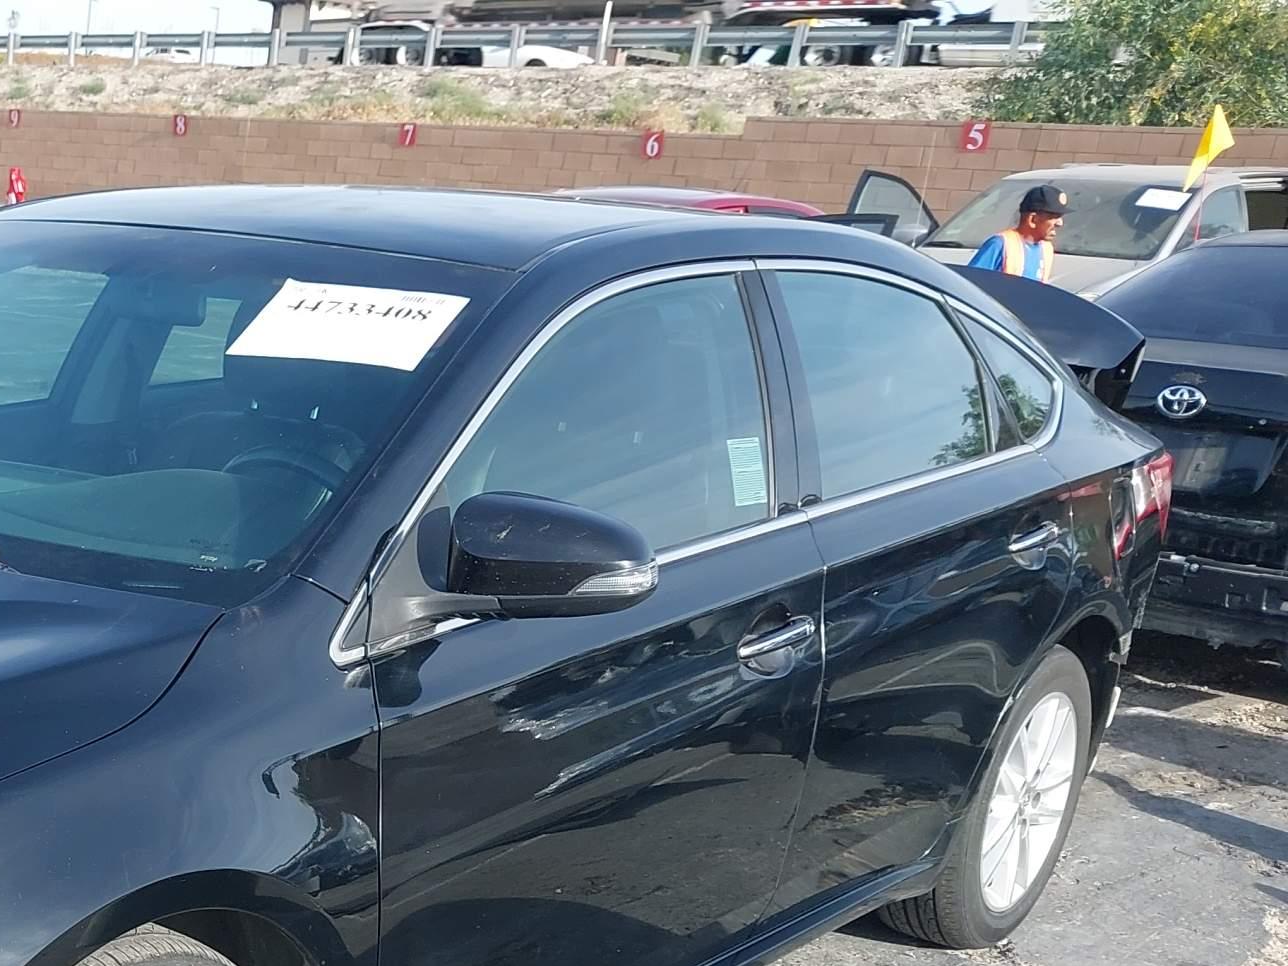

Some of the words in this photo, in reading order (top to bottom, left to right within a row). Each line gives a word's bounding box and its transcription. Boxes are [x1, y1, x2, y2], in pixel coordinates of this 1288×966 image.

[10, 110, 19, 128] 9
[176, 116, 185, 135] 8
[403, 124, 414, 145] 7
[646, 133, 660, 157] 6
[966, 123, 986, 150] 5
[287, 299, 432, 320] 44733408
